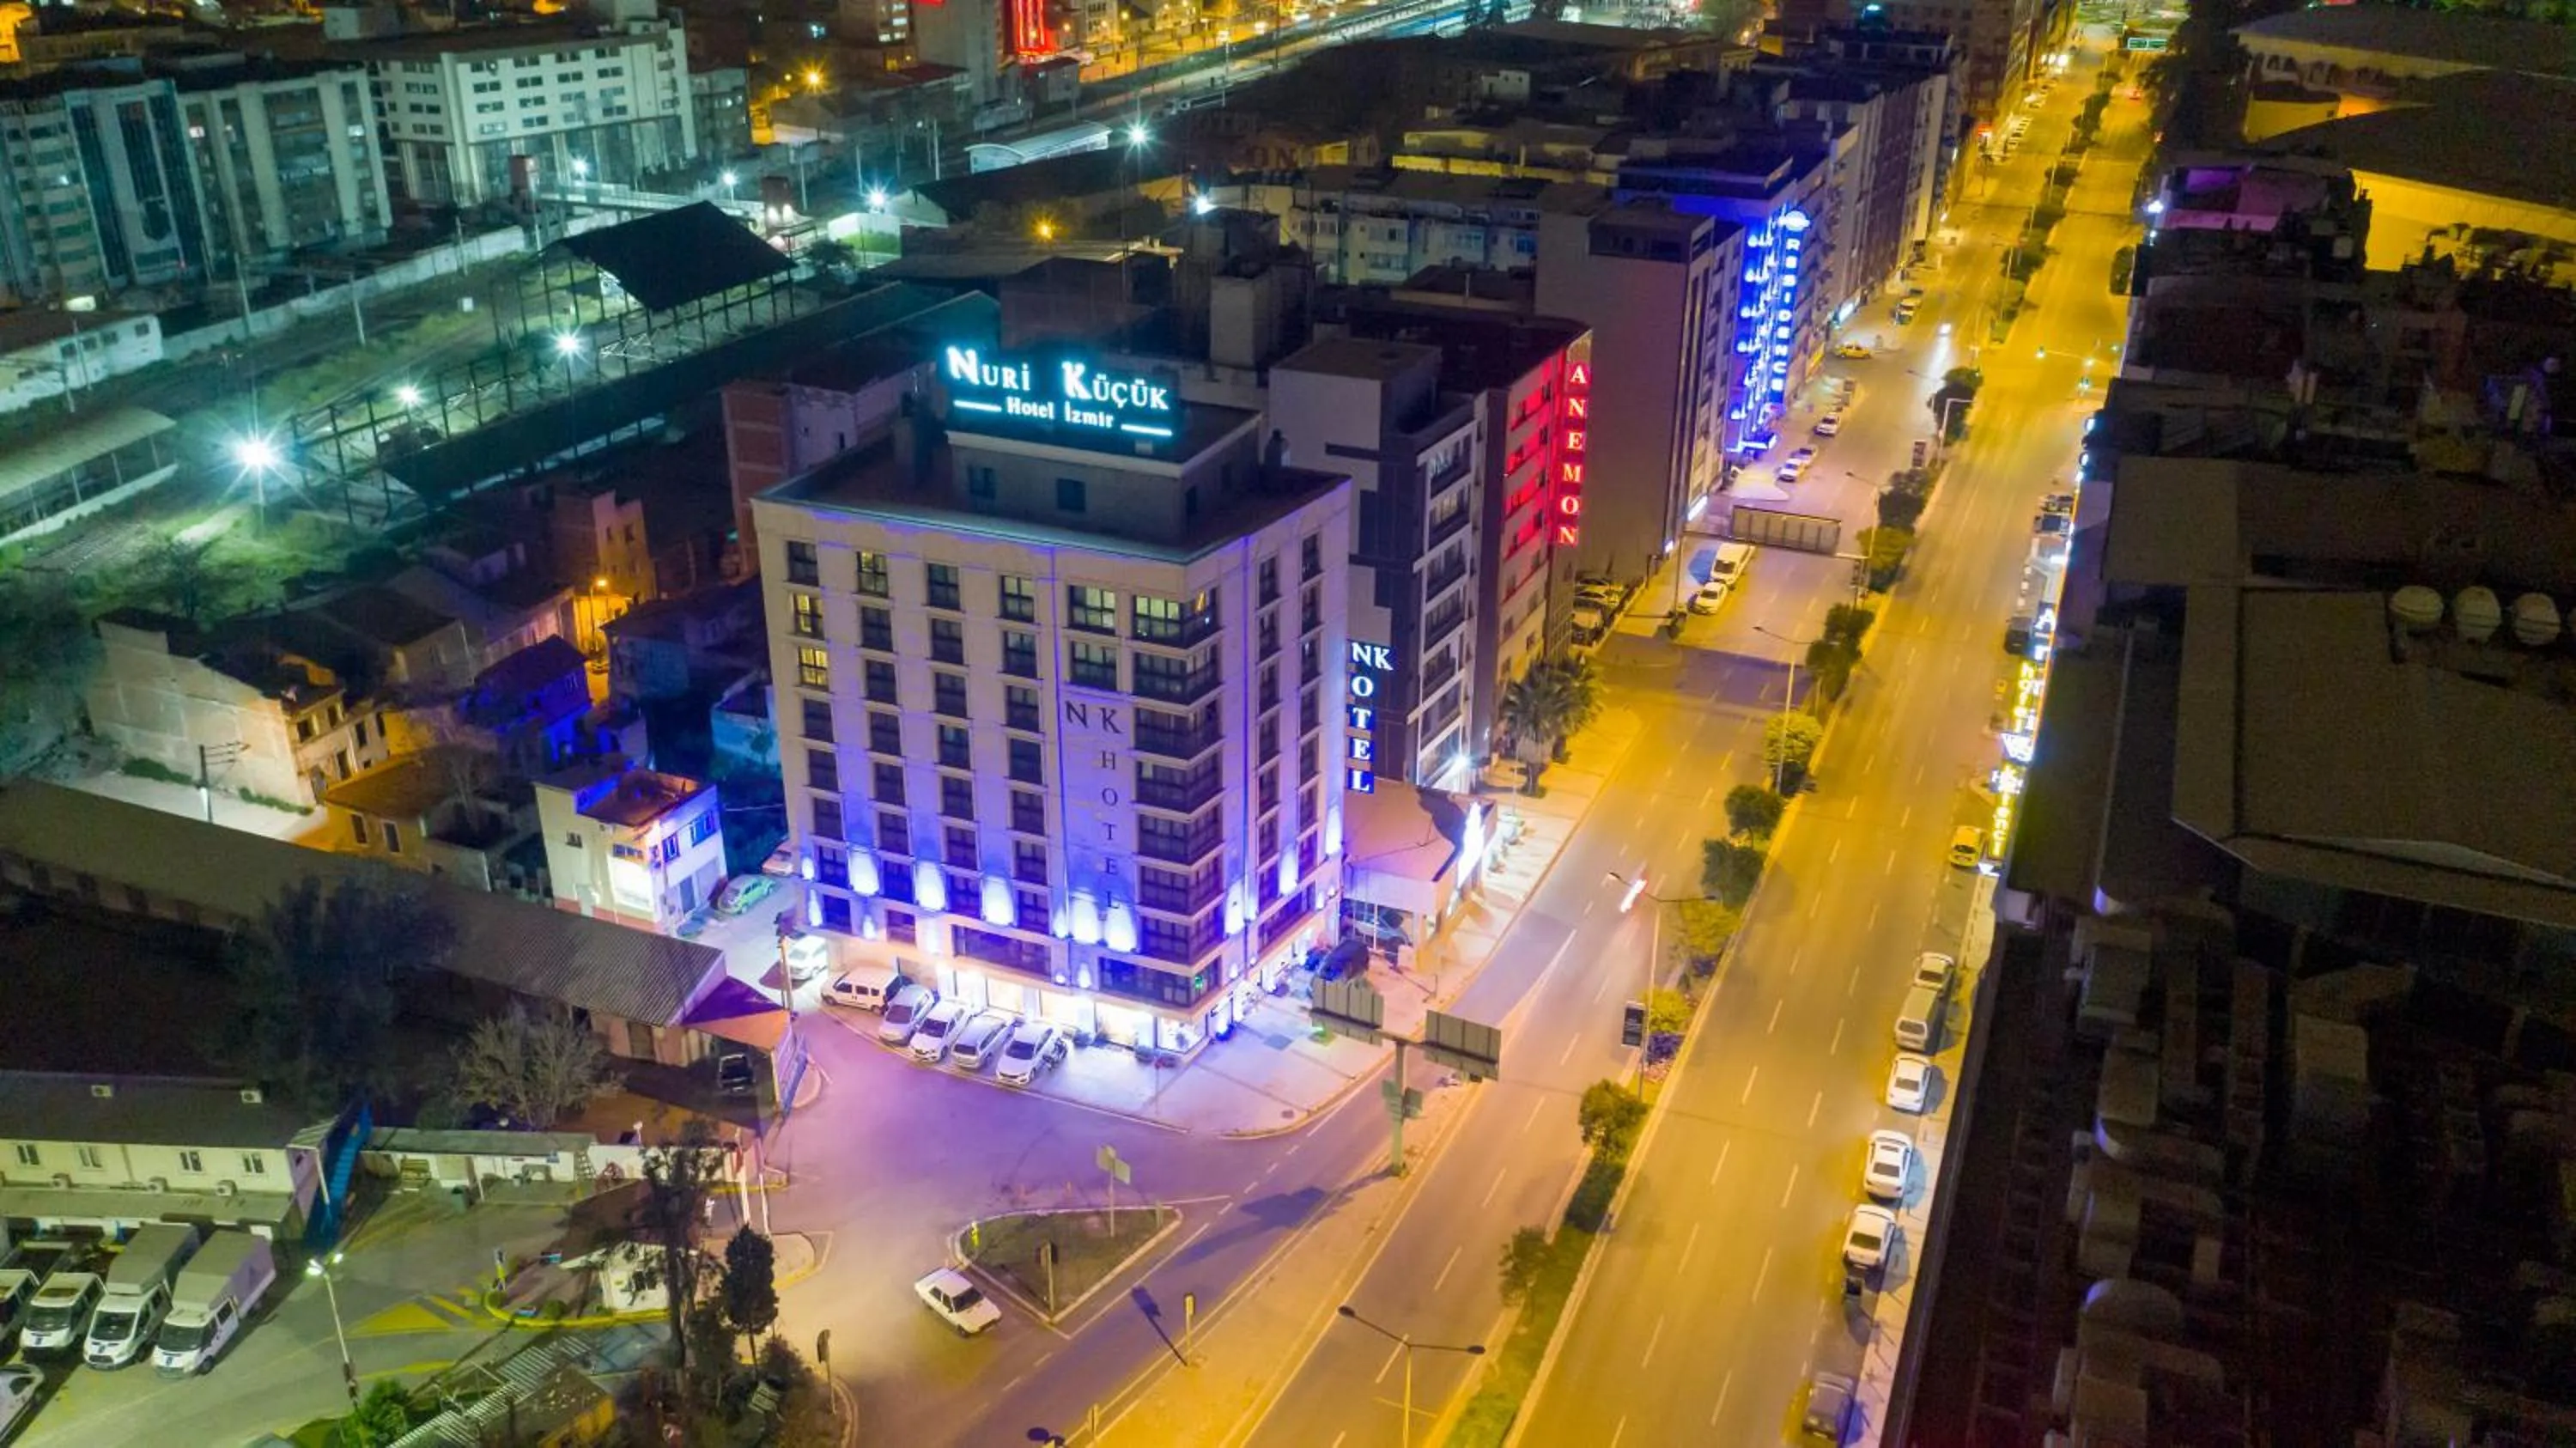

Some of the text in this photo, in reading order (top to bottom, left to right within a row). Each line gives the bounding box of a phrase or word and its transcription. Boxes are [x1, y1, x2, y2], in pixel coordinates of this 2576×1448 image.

[1006, 397, 1054, 420] Hotel
[1061, 361, 1170, 411] KÜÇÜK
[1558, 364, 1588, 545] ANEMON
[1101, 751, 1121, 909] HOTEL
